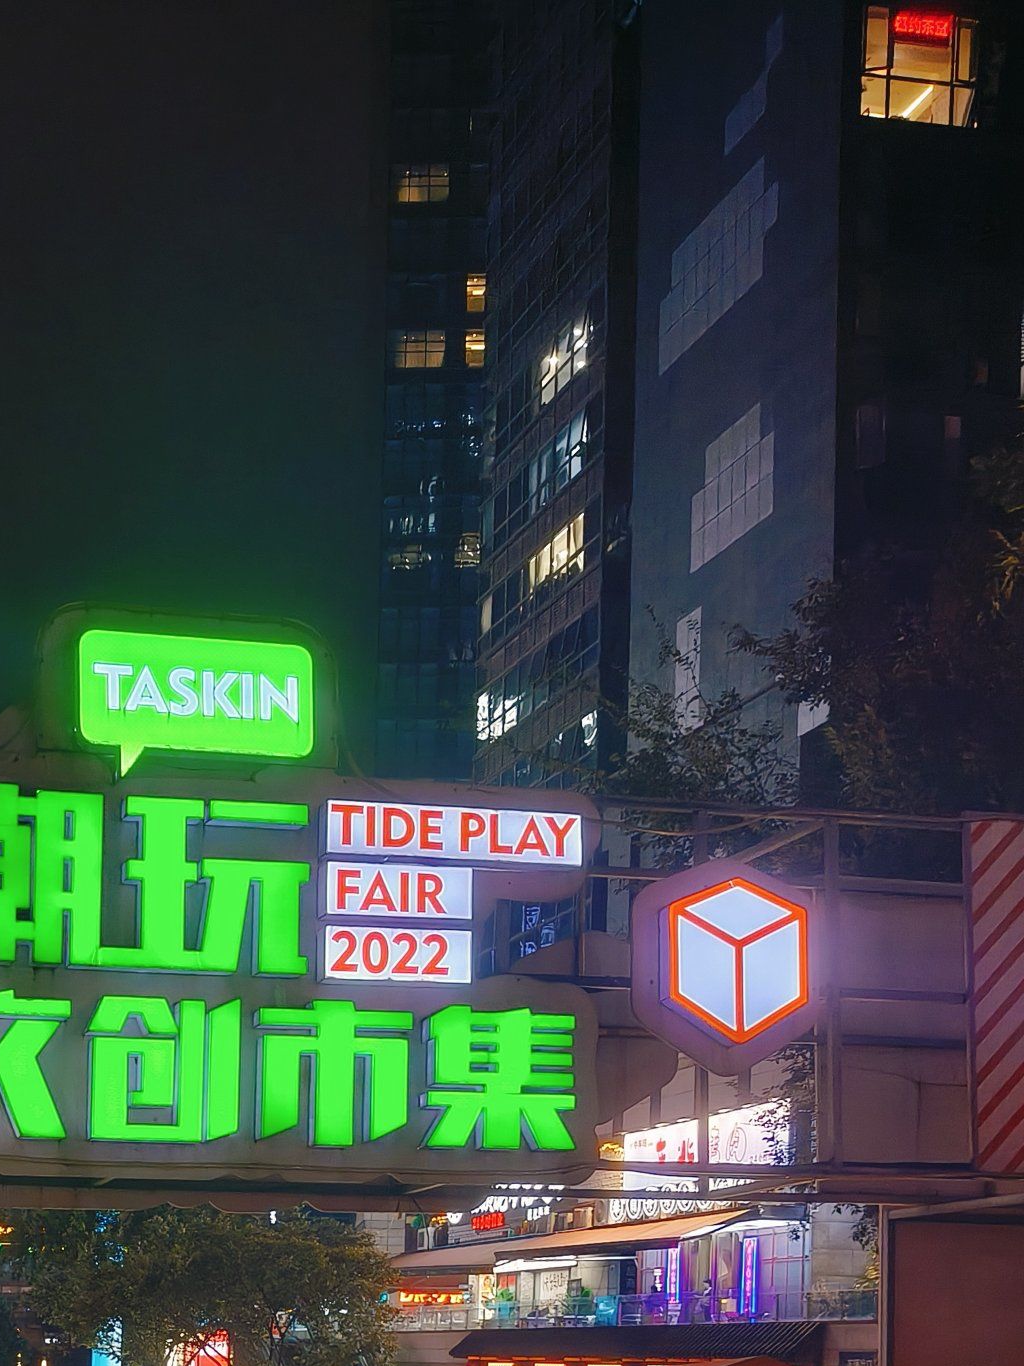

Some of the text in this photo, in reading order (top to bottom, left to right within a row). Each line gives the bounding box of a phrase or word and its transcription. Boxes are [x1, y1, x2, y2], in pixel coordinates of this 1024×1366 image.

[93, 662, 299, 724] TASKIN
[330, 803, 577, 858] TIDE PLAY
[337, 868, 447, 914] FAIR
[329, 931, 449, 977] 2022
